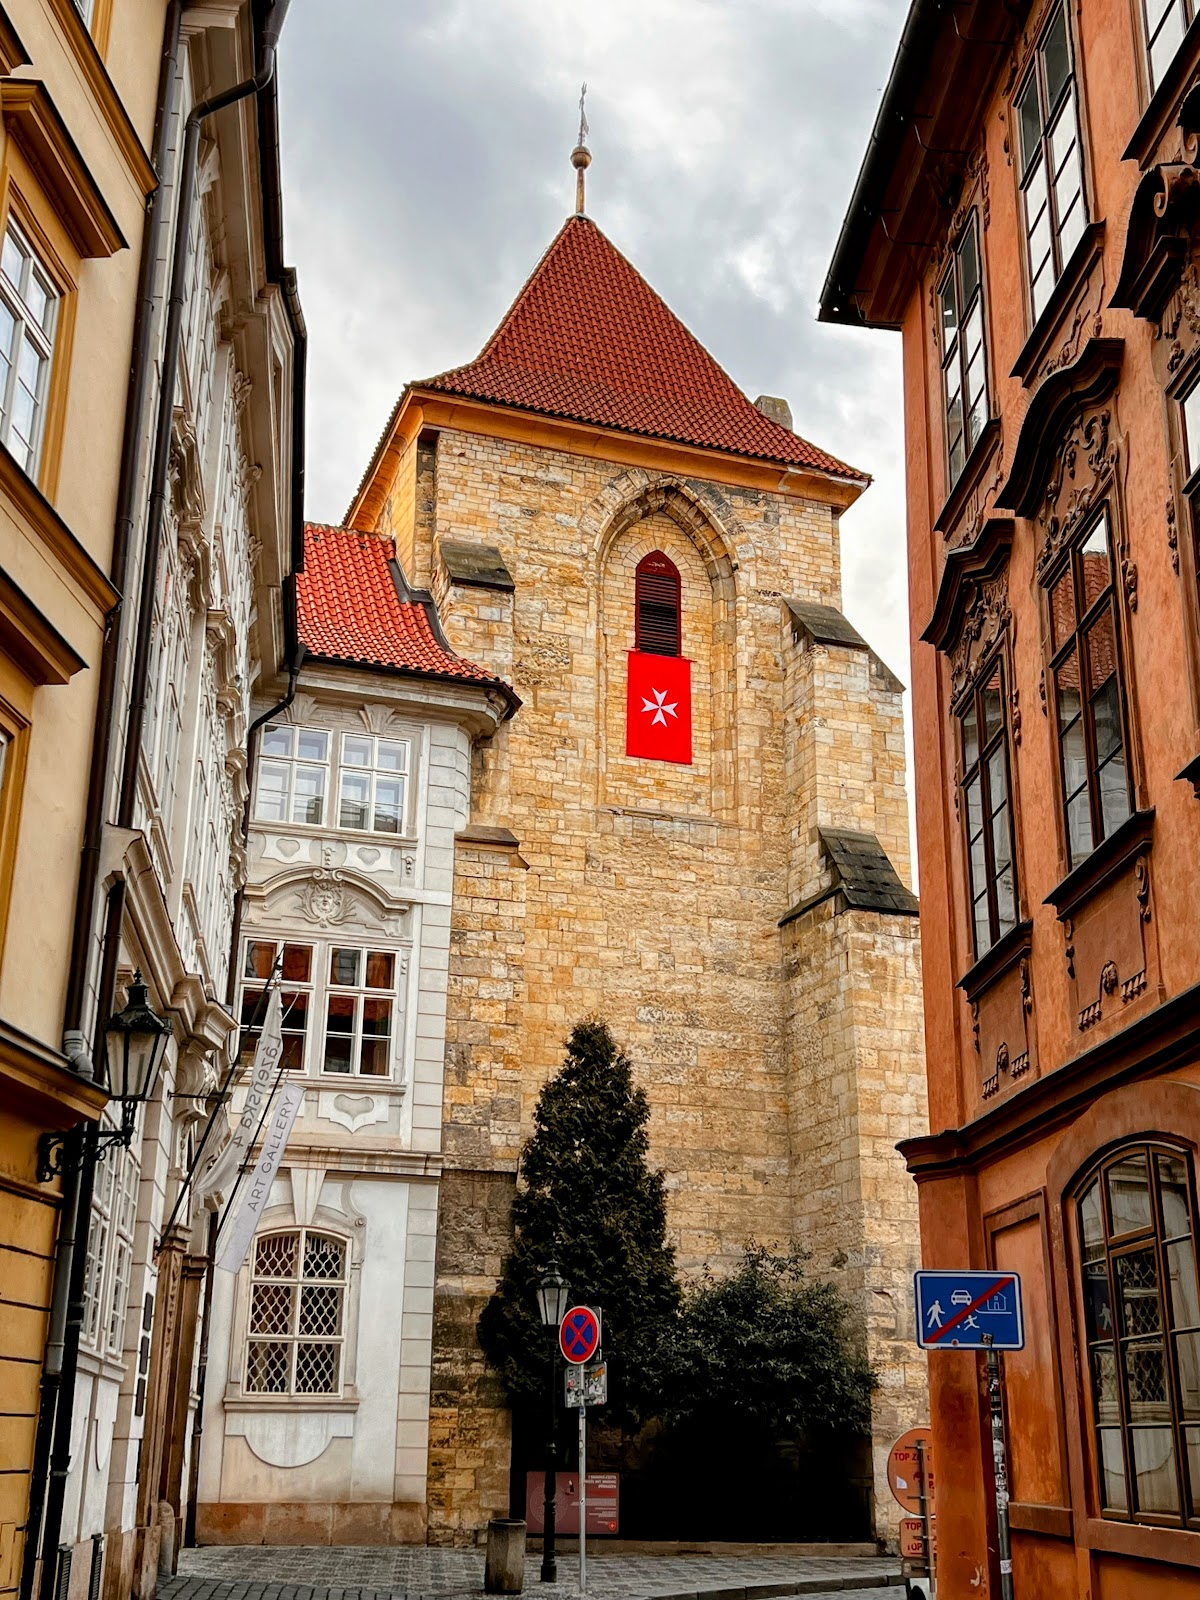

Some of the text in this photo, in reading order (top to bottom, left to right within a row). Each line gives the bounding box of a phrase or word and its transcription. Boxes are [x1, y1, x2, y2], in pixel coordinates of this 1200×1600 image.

[247, 1096, 294, 1212] ART GALLERY
[894, 1452, 910, 1461] TOP
[905, 1522, 922, 1531] TOP
